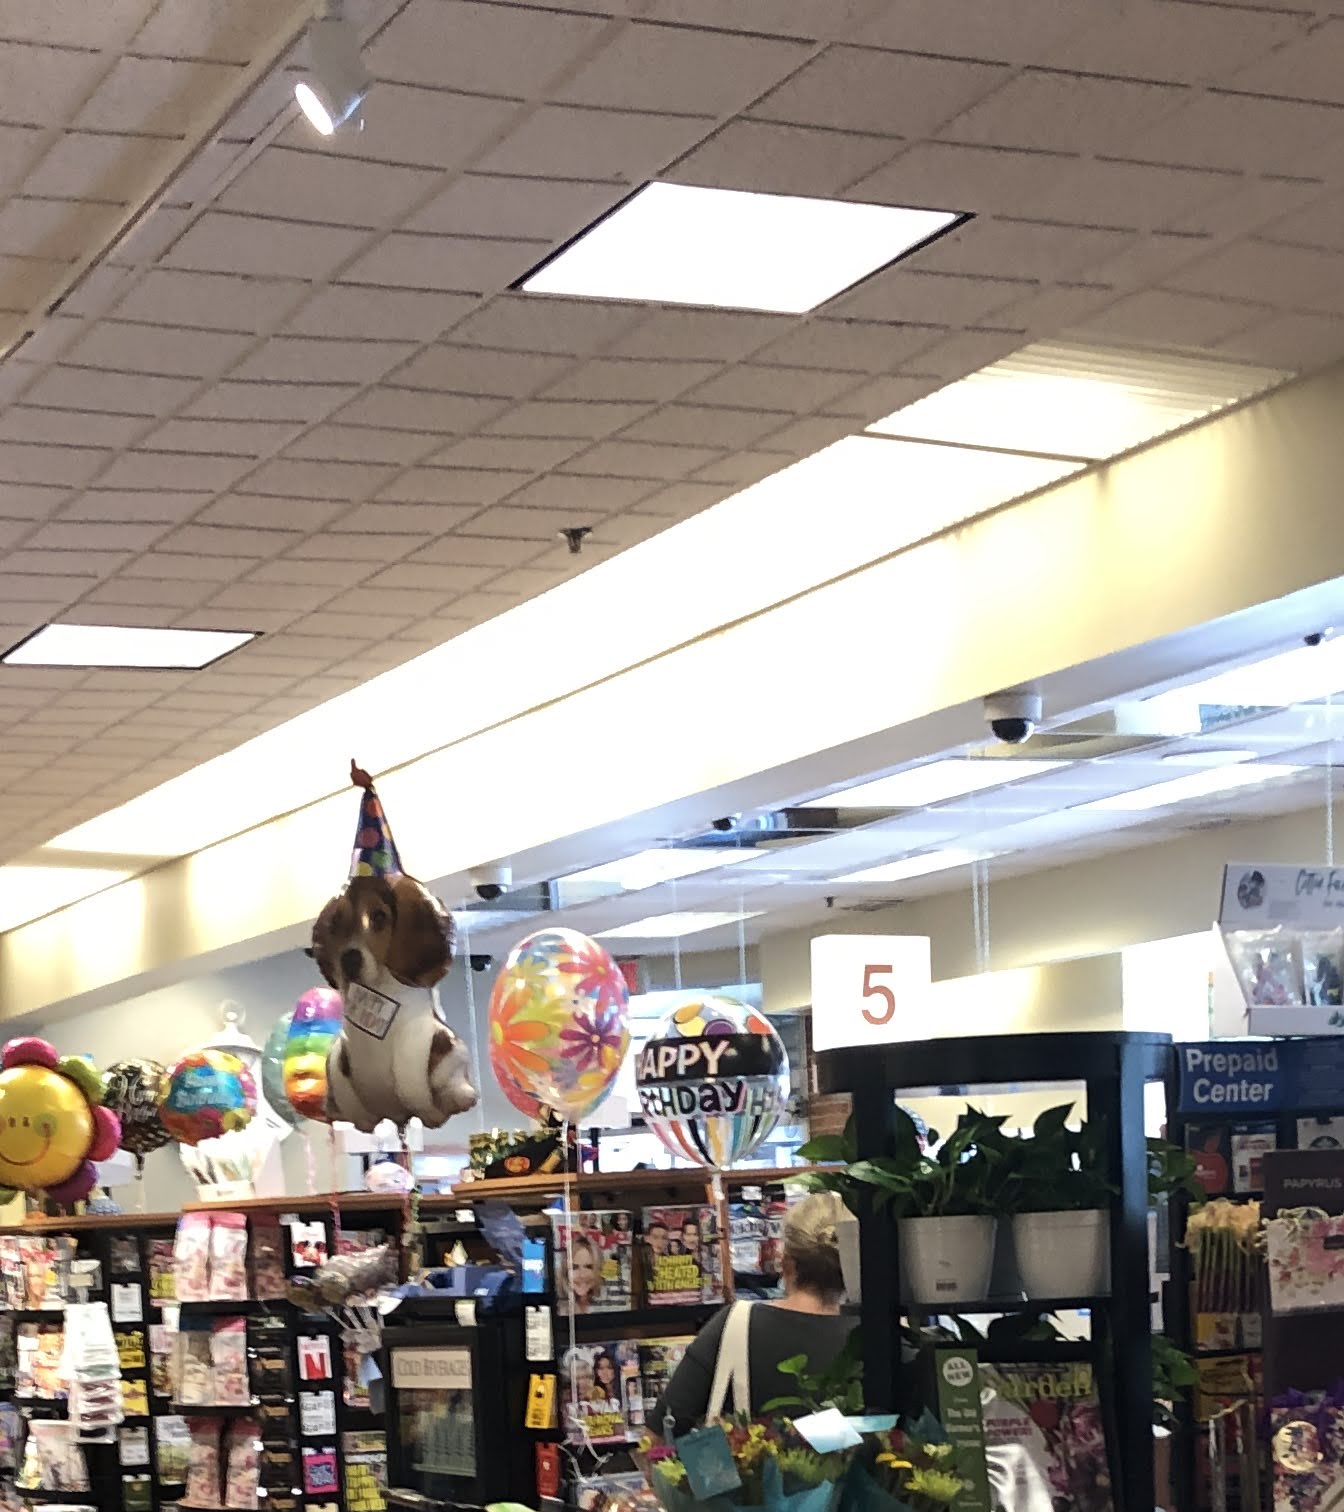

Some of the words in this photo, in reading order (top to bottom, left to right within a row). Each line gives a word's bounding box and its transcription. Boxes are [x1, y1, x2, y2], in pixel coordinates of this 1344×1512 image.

[861, 964, 896, 1025] 5
[1186, 1048, 1278, 1077] Prepaid
[1193, 1079, 1273, 1103] Center
[1283, 1178, 1342, 1189] PAPYRUS
[947, 1370, 971, 1381] NEW
